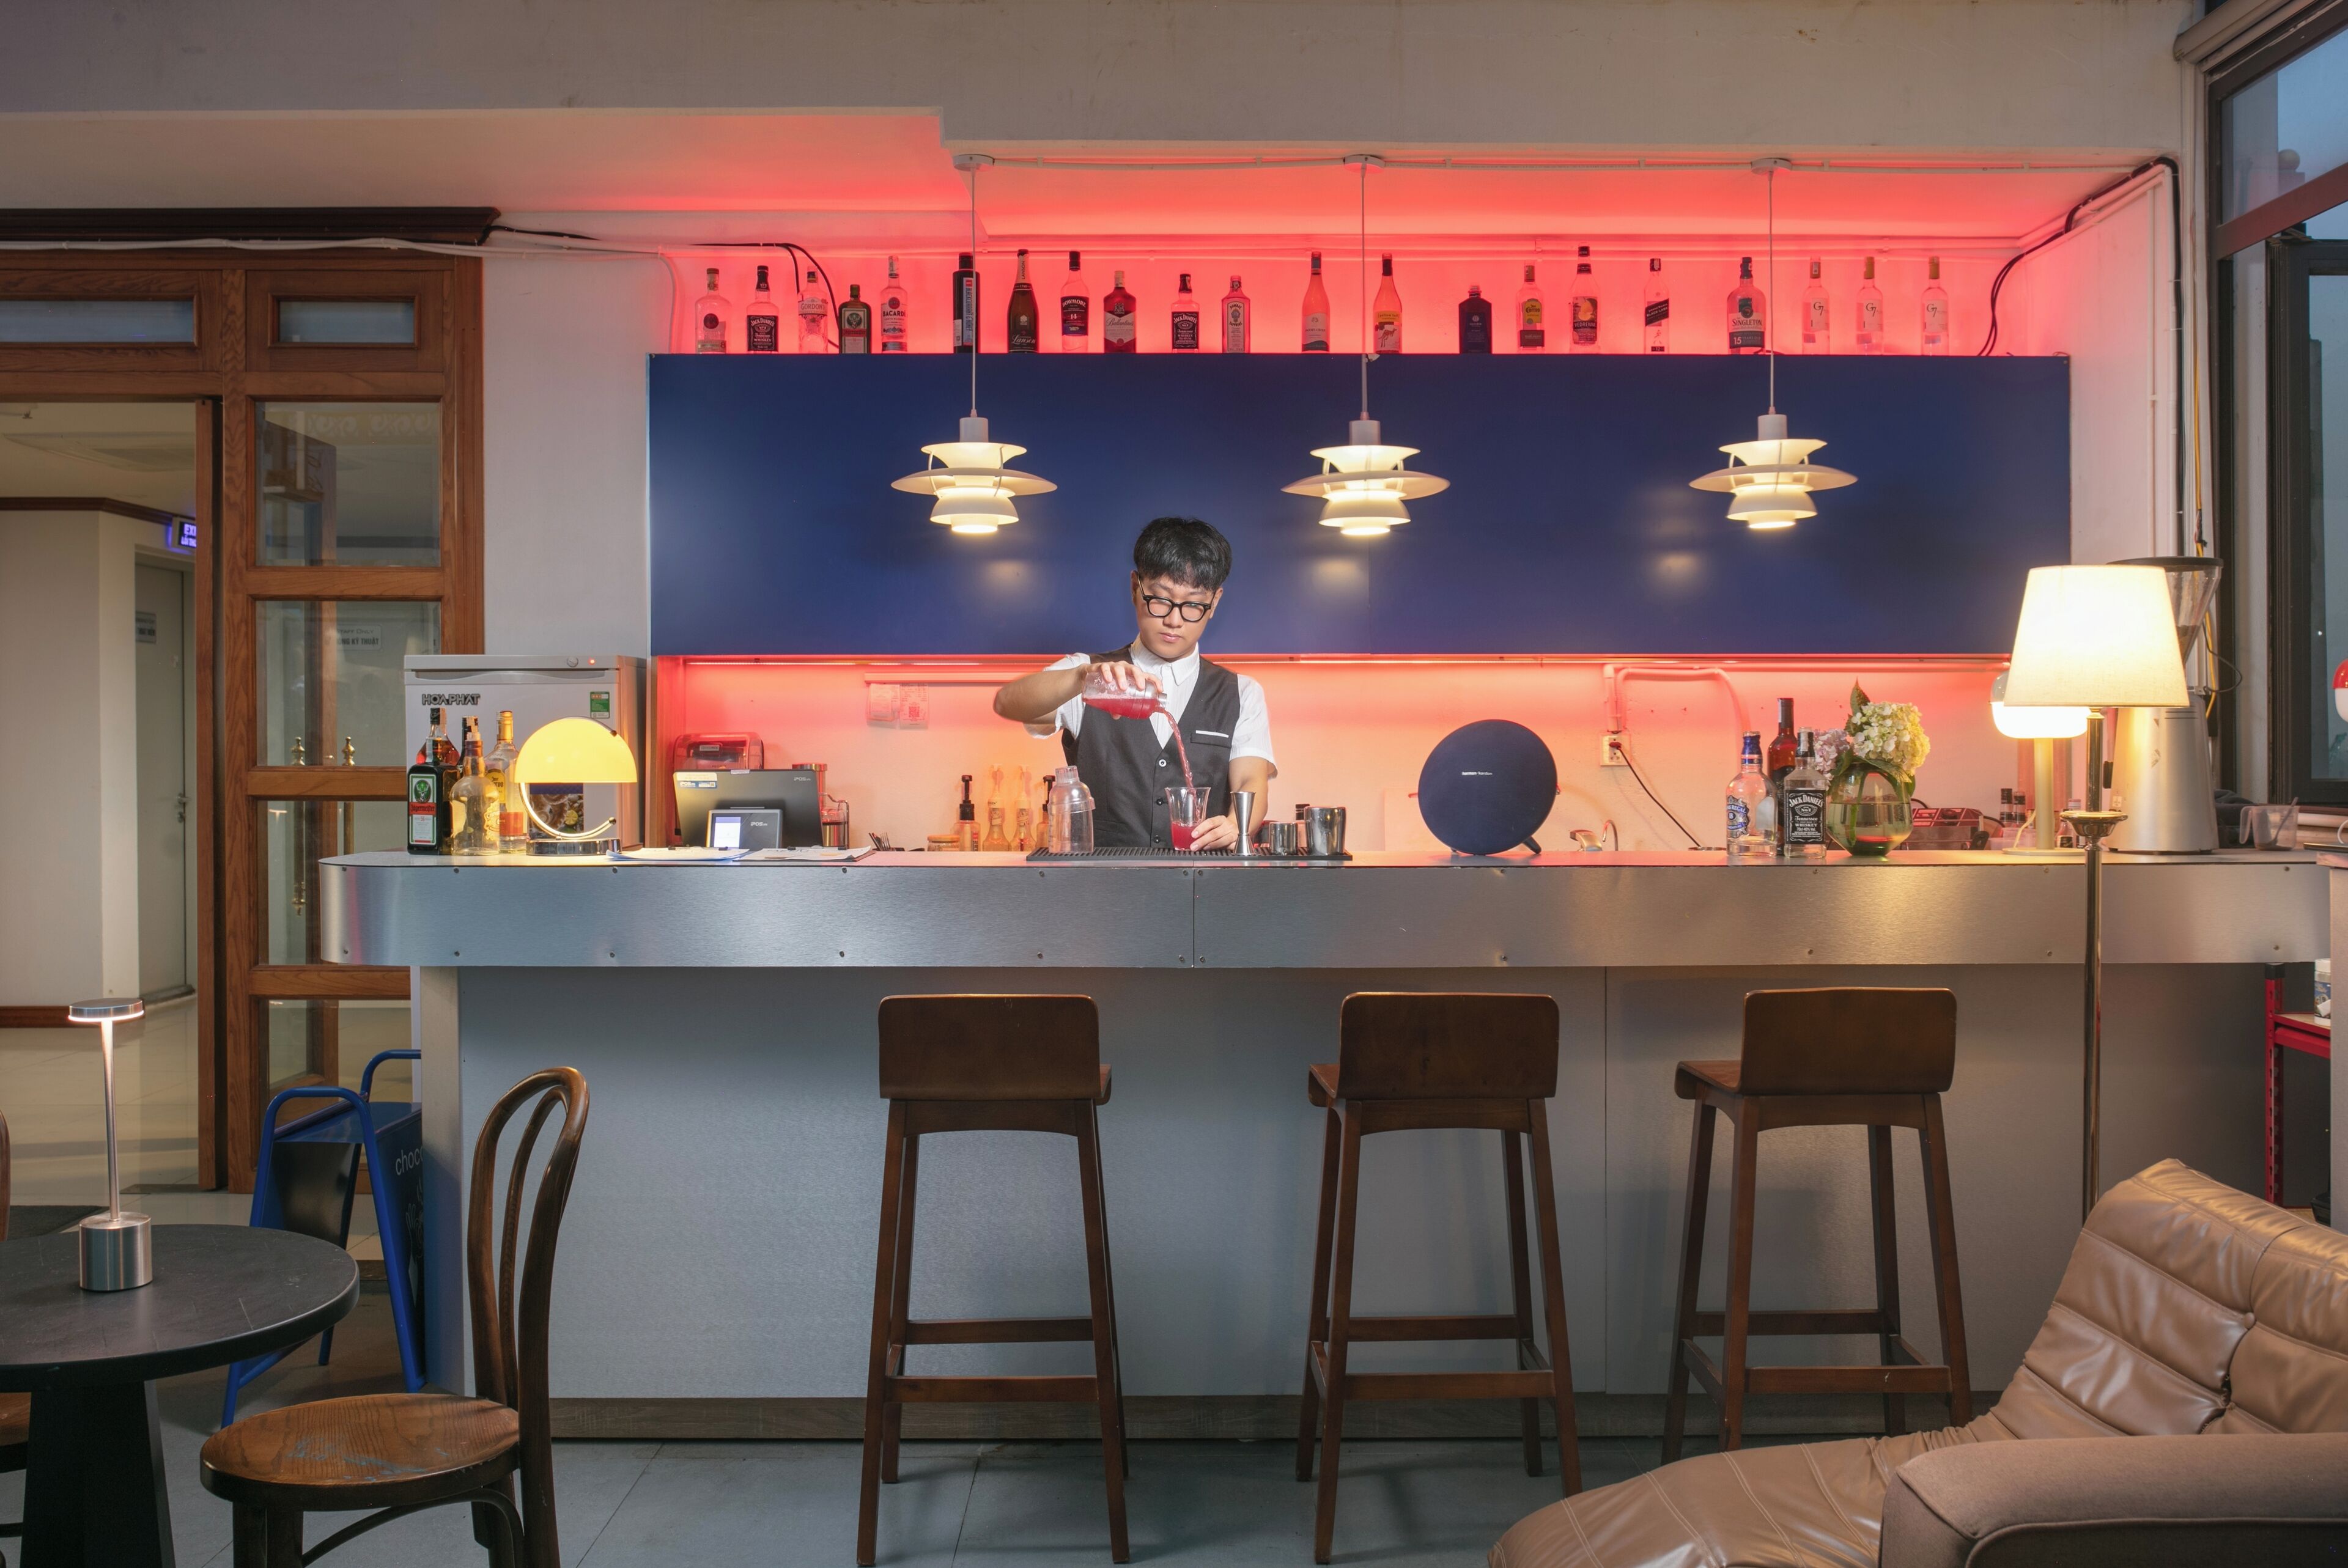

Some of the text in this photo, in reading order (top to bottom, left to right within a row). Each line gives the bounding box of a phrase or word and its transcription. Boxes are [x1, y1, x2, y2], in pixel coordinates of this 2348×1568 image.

[1732, 318, 1762, 326] SINGLETON
[1012, 335, 1036, 344] Lanson
[1733, 336, 1742, 345] 15
[183, 522, 196, 536] EXI
[1789, 794, 1823, 807] JACK DANIEL'S
